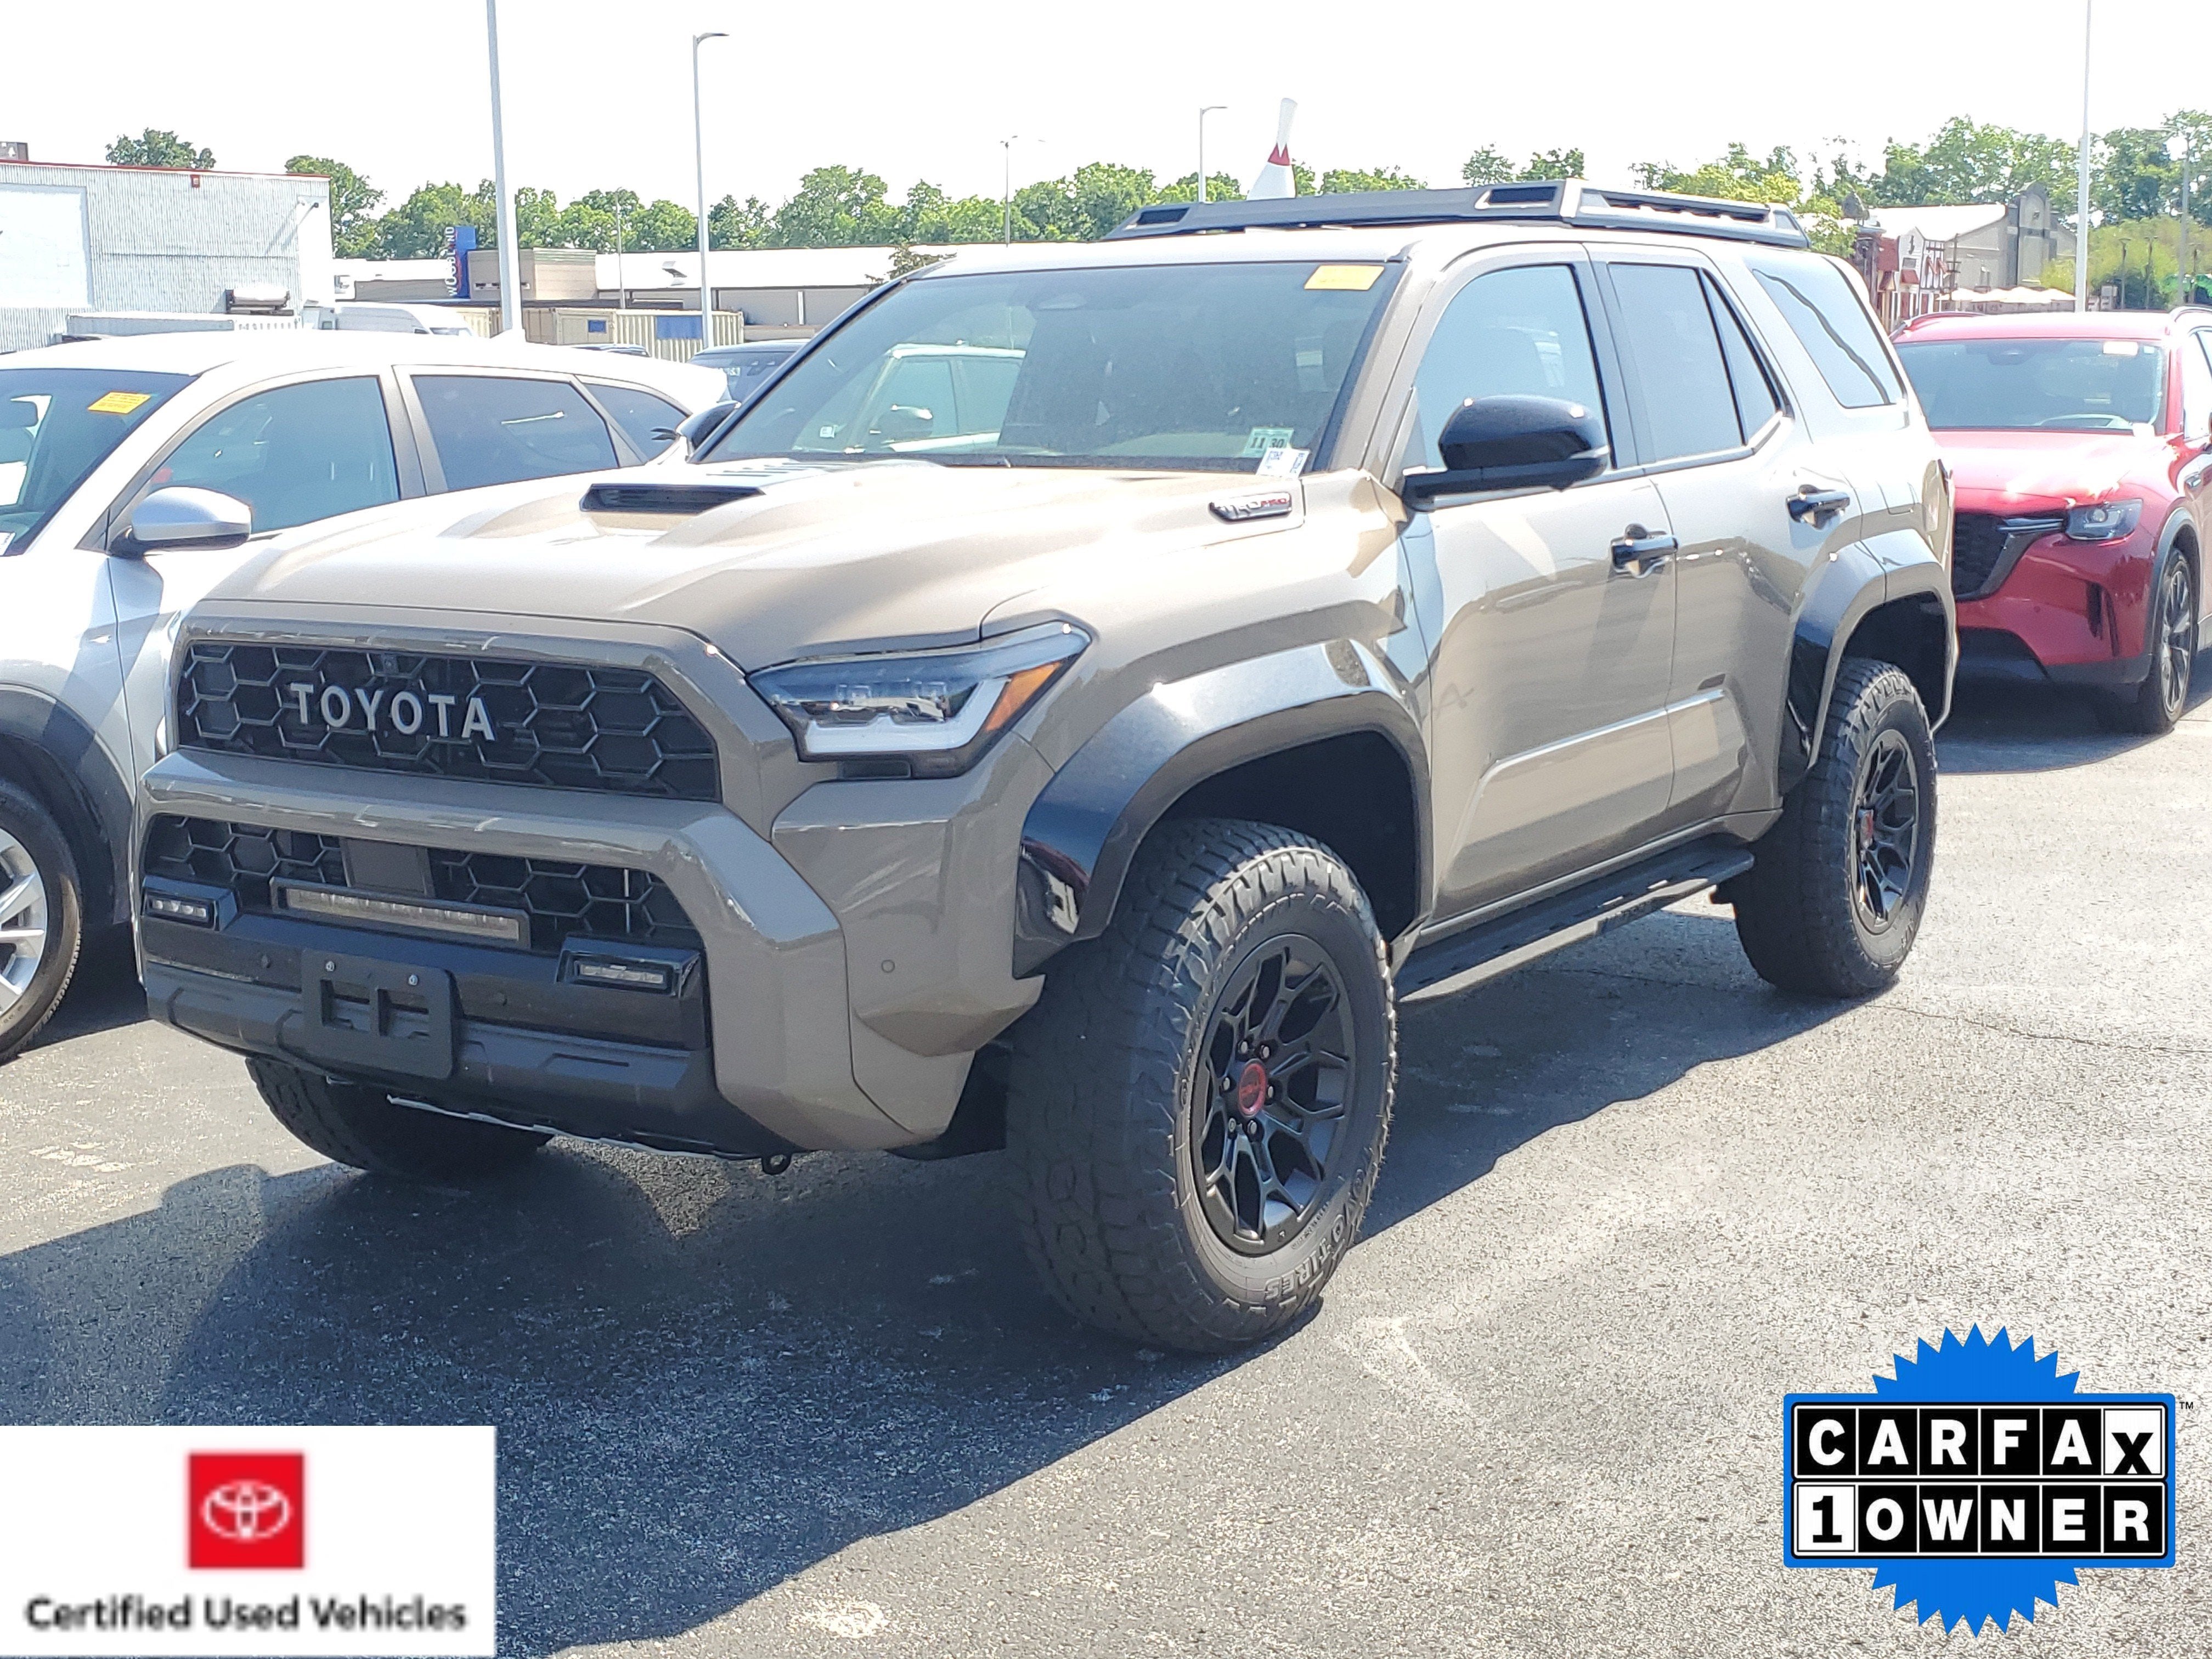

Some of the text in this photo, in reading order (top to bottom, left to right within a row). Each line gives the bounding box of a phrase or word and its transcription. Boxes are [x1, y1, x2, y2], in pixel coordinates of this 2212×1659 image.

[1250, 438, 1284, 449] 11 30
[290, 682, 495, 741] TOYOTA
[1264, 1237, 1332, 1301] TIRES
